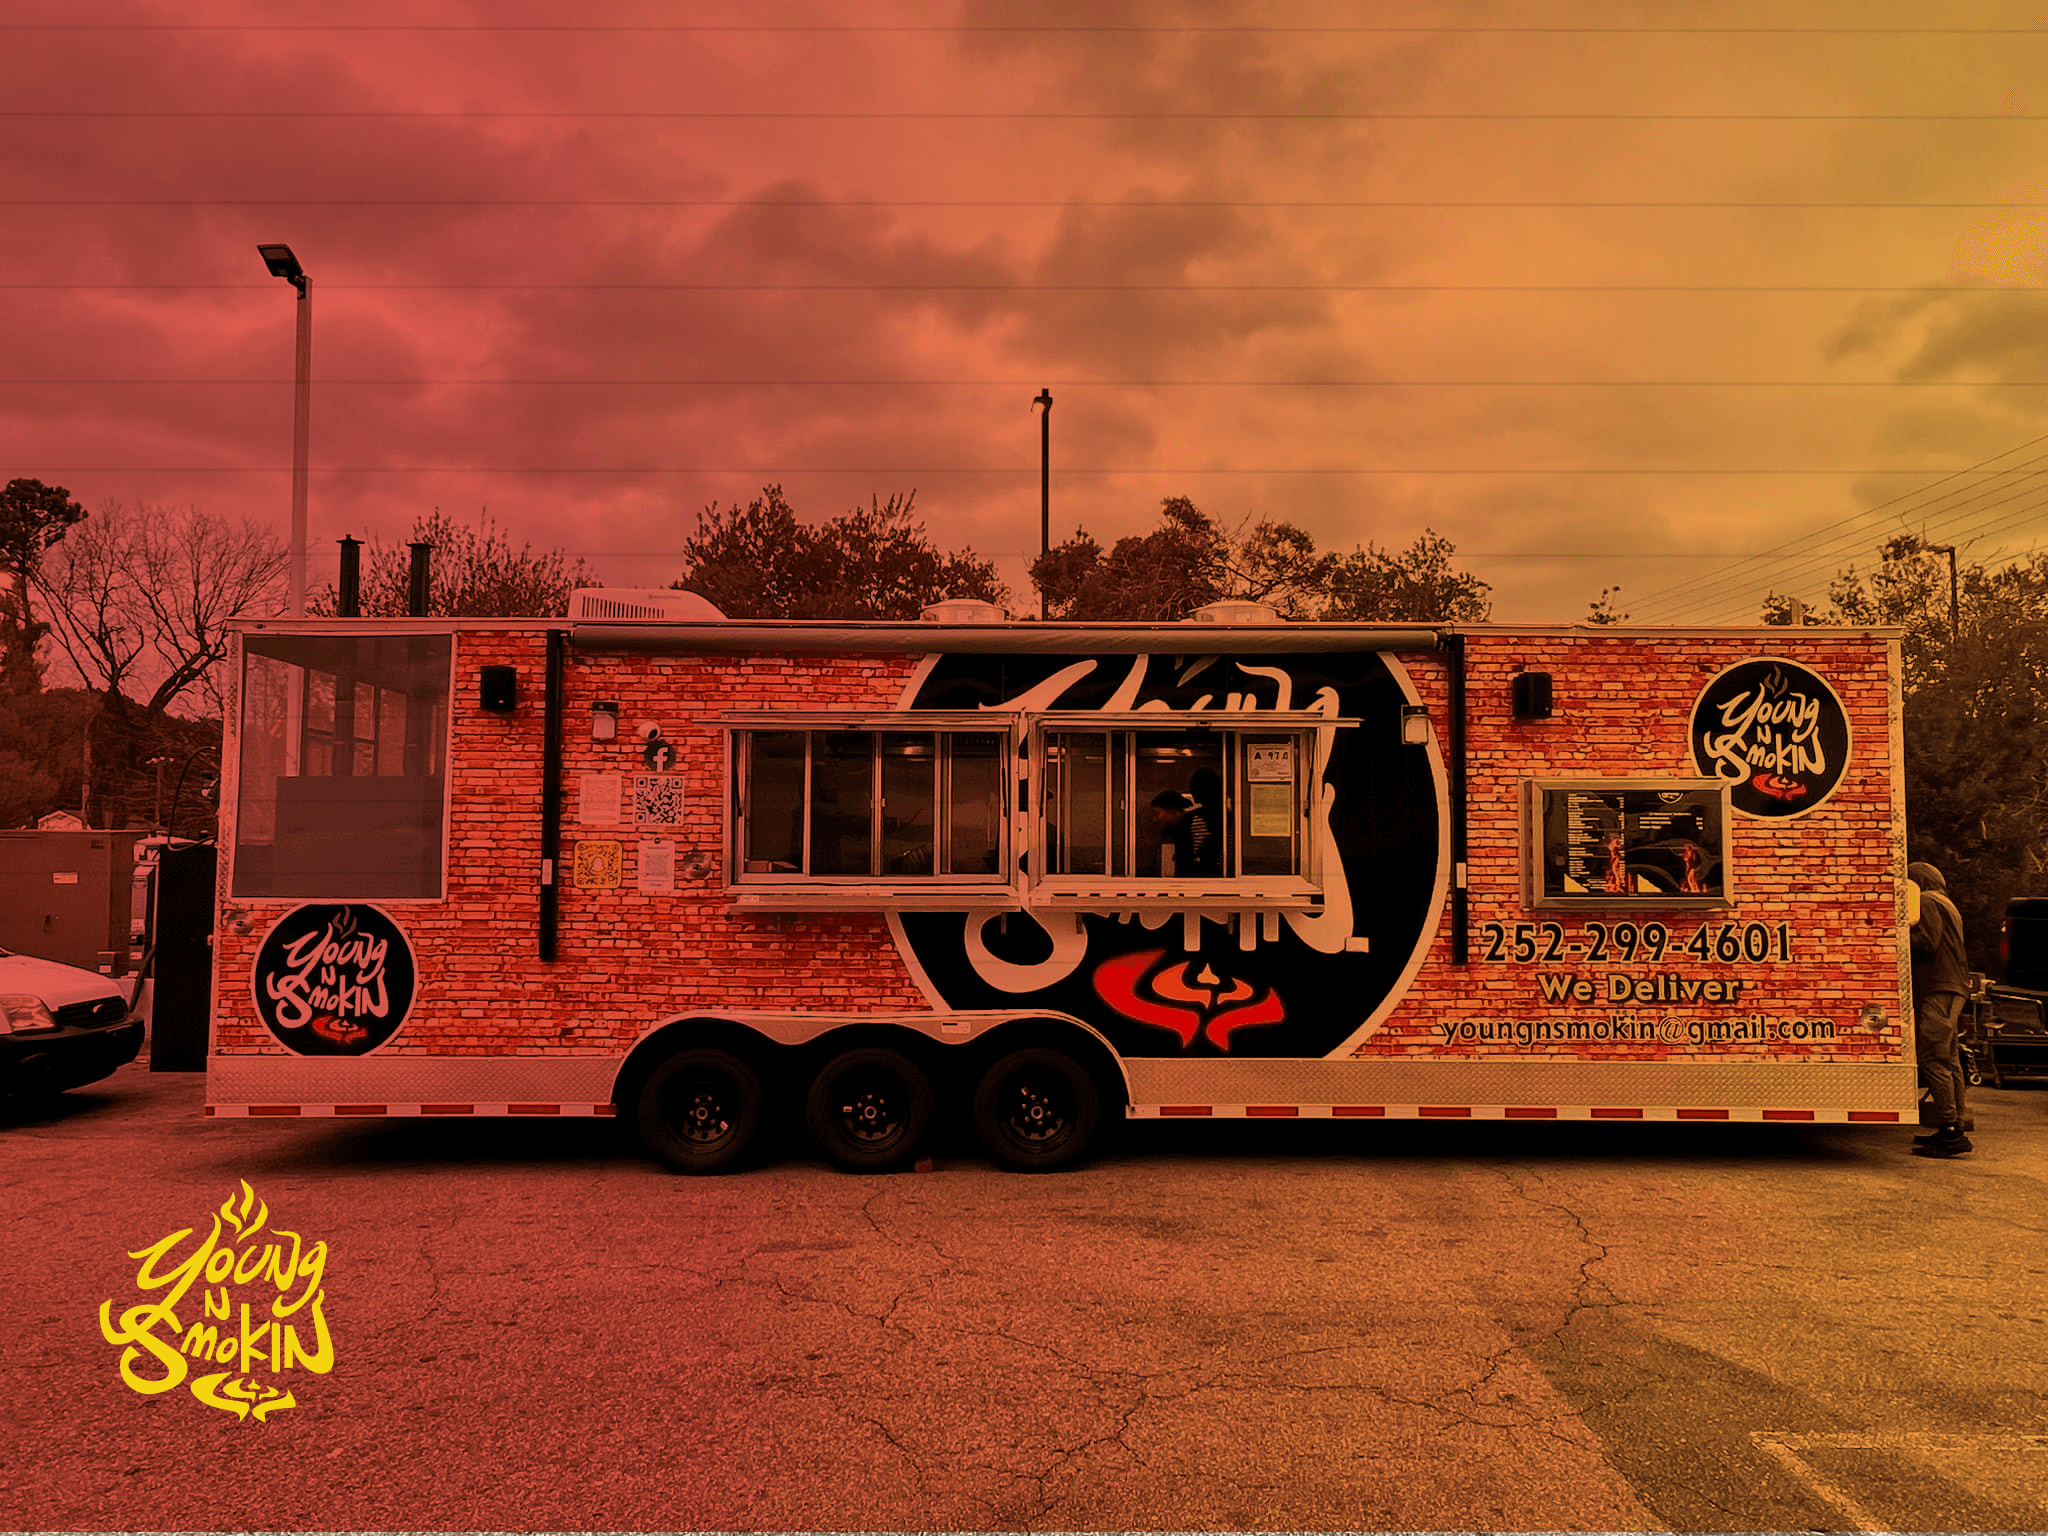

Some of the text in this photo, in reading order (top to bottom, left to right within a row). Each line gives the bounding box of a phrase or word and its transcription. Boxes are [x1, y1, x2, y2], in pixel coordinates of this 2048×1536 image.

[1481, 921, 1794, 963] 252-299-4601
[1538, 974, 1741, 1001] We Deliver
[1443, 1015, 1837, 1045] youngnsmokin@gmail.com
